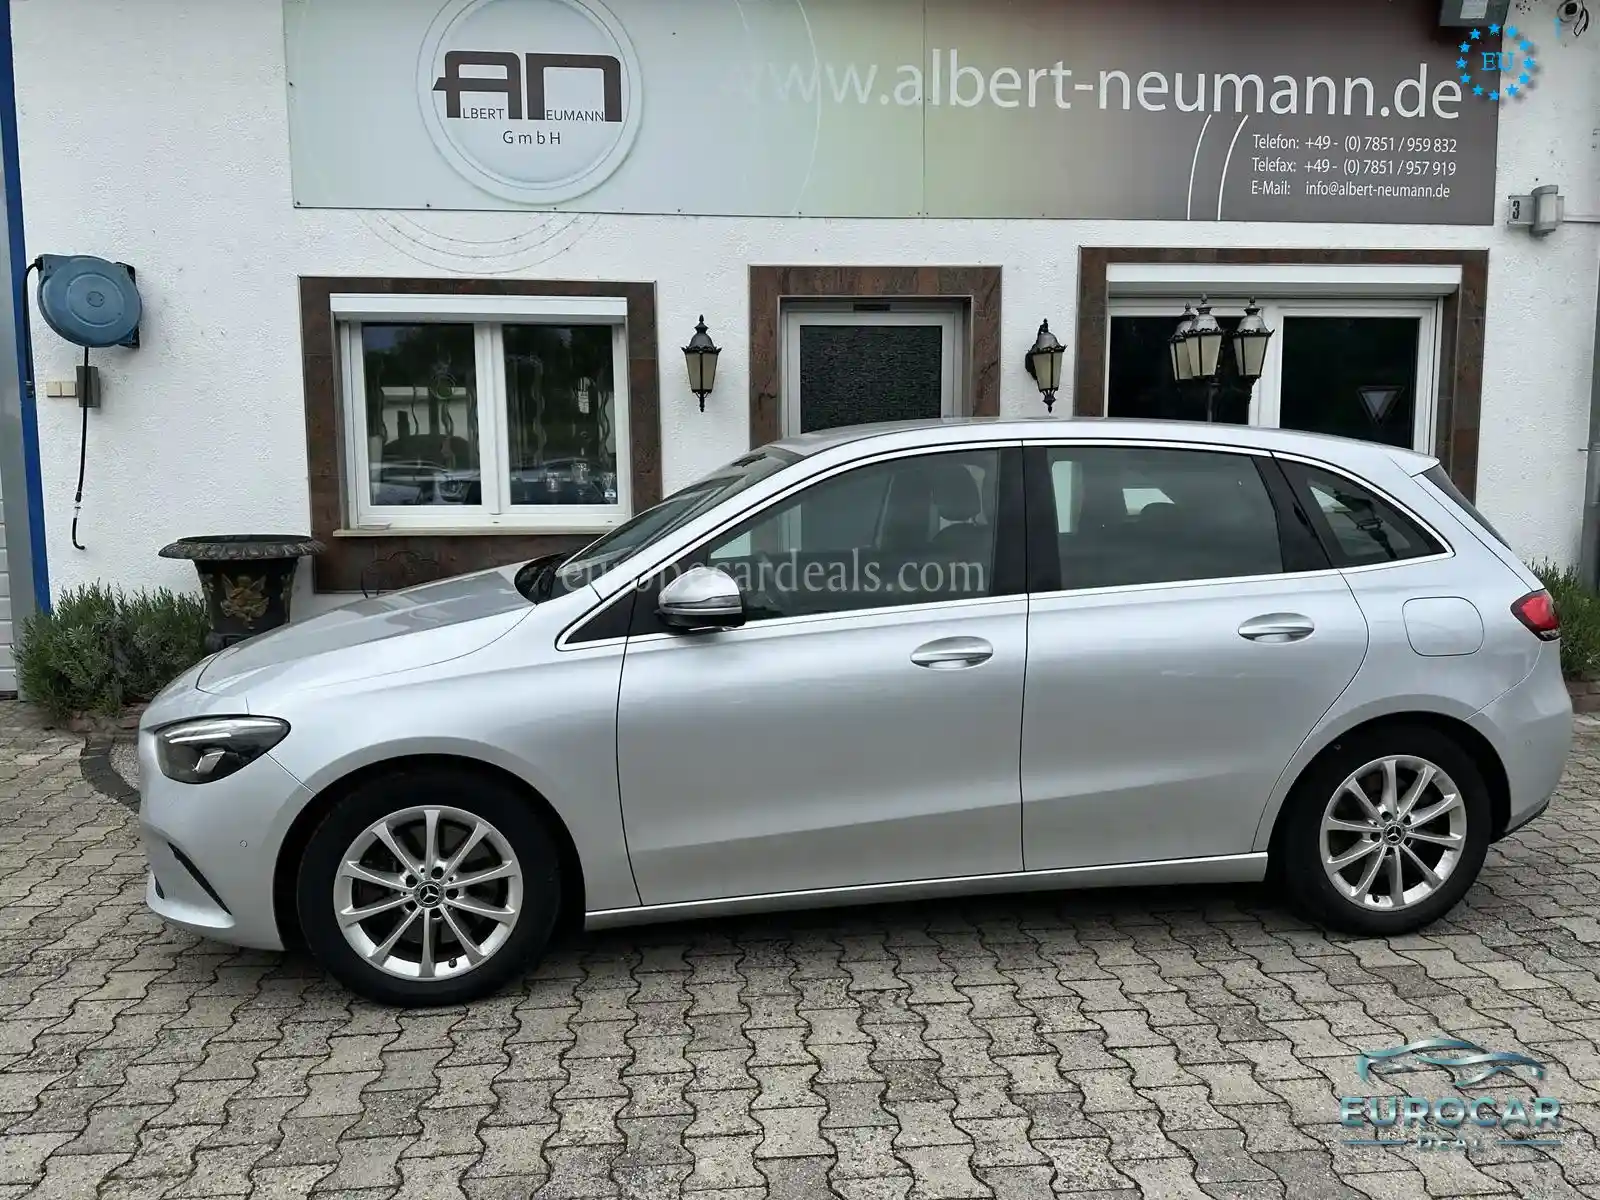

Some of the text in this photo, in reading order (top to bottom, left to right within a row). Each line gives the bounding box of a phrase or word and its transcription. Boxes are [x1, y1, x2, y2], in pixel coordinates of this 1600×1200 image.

[730, 48, 1463, 120] ww.albert-neumann.de
[502, 130, 562, 145] GmbH
[1252, 134, 1300, 149] Telefon:
[1344, 135, 1361, 153] (0)
[1364, 136, 1395, 151] 7851
[1407, 137, 1431, 152] 959
[1433, 138, 1457, 153] 832
[1252, 157, 1297, 172] Telefax:
[1343, 159, 1360, 176] (0)
[1363, 160, 1394, 175] 7851
[1406, 161, 1430, 175] 957
[1433, 161, 1456, 176] 919
[1251, 181, 1450, 198] E-Mail: info@albert-neumann.de
